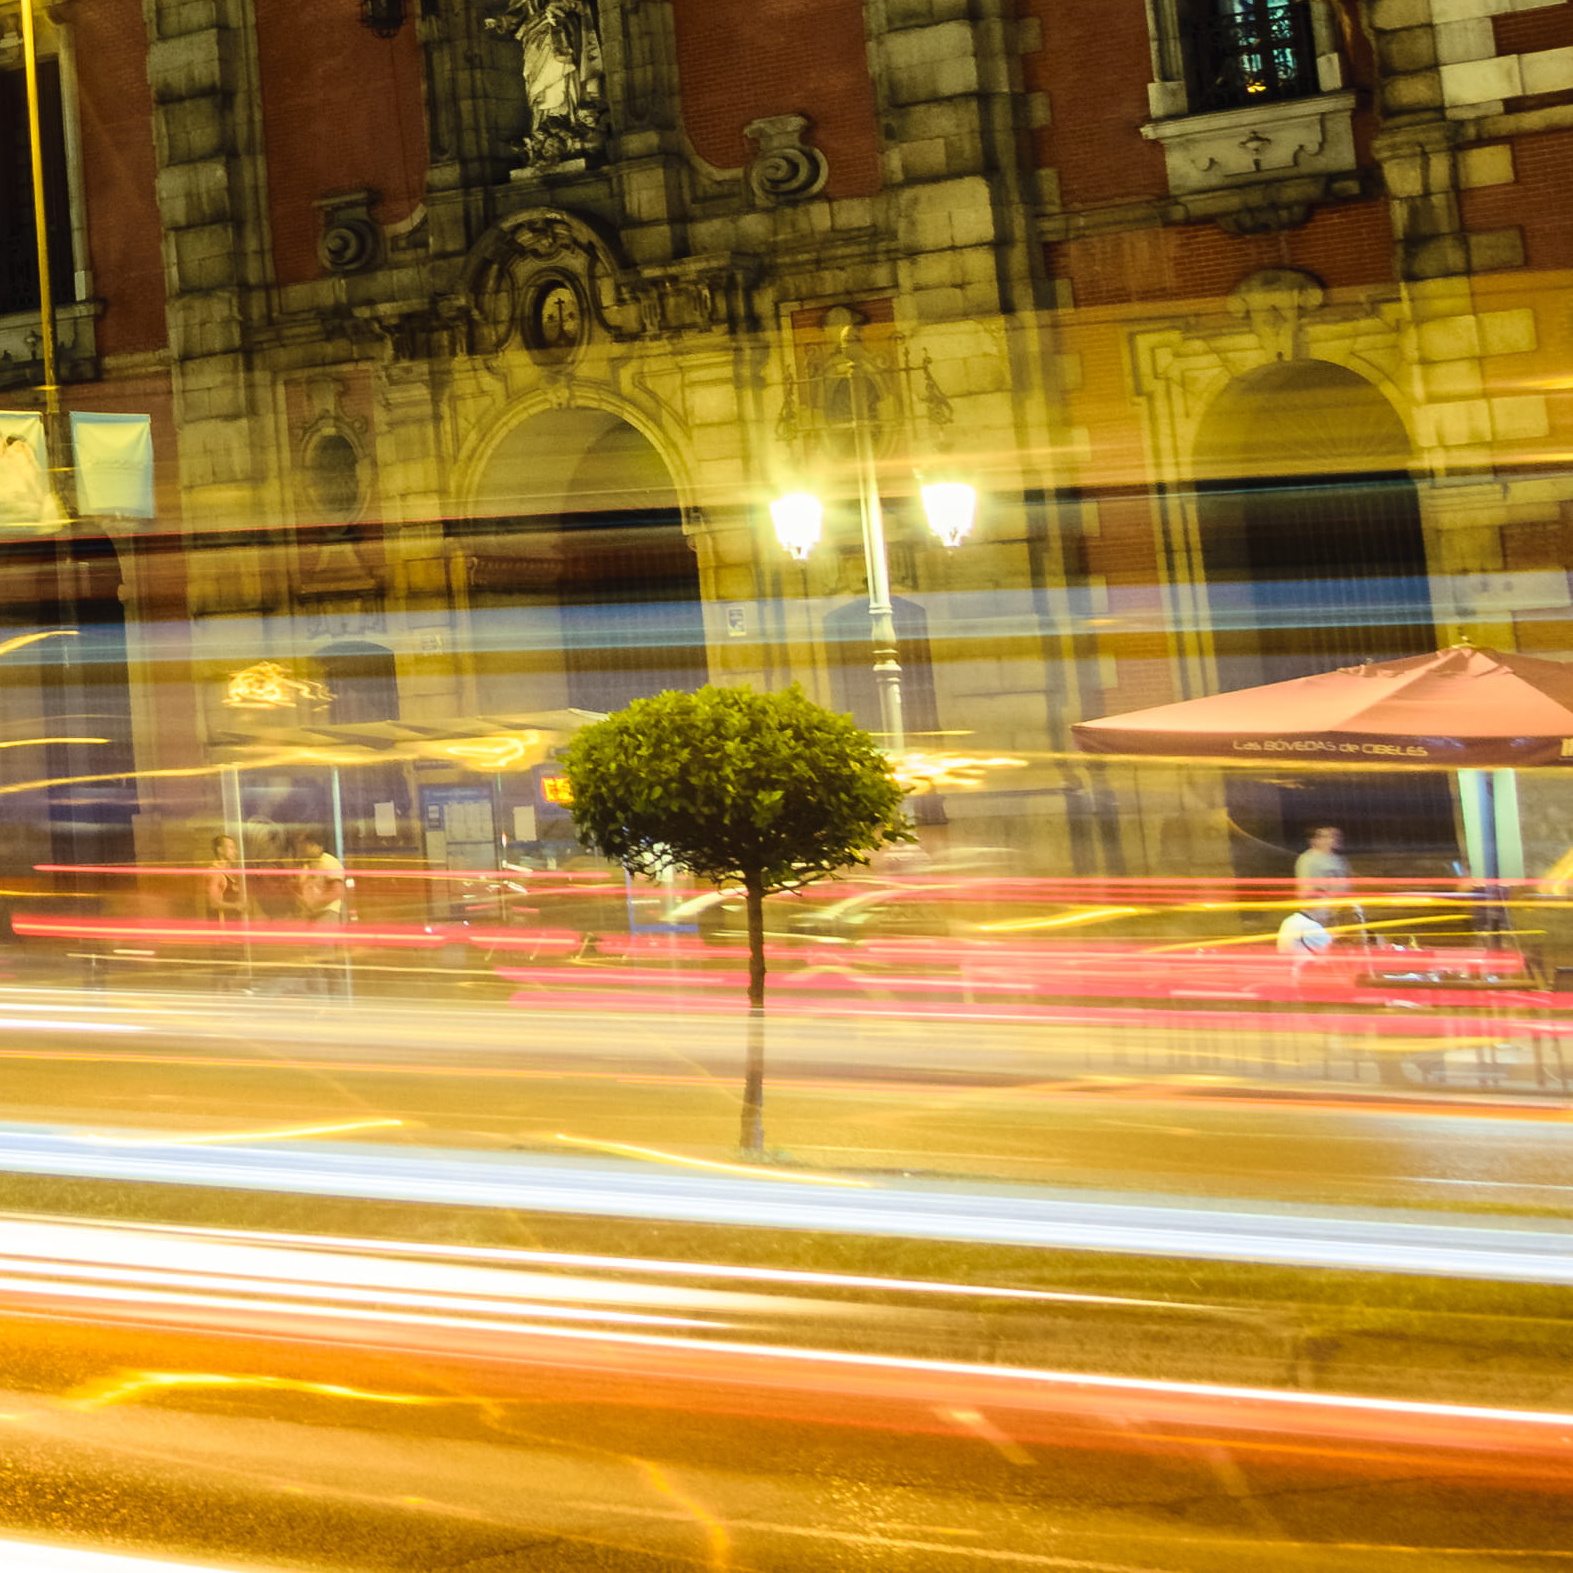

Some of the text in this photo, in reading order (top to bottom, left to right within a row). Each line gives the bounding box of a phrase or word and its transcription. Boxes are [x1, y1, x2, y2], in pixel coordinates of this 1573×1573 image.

[1233, 739, 1262, 751] Las
[1339, 743, 1359, 753] de
[1362, 743, 1429, 757] CIBELES
